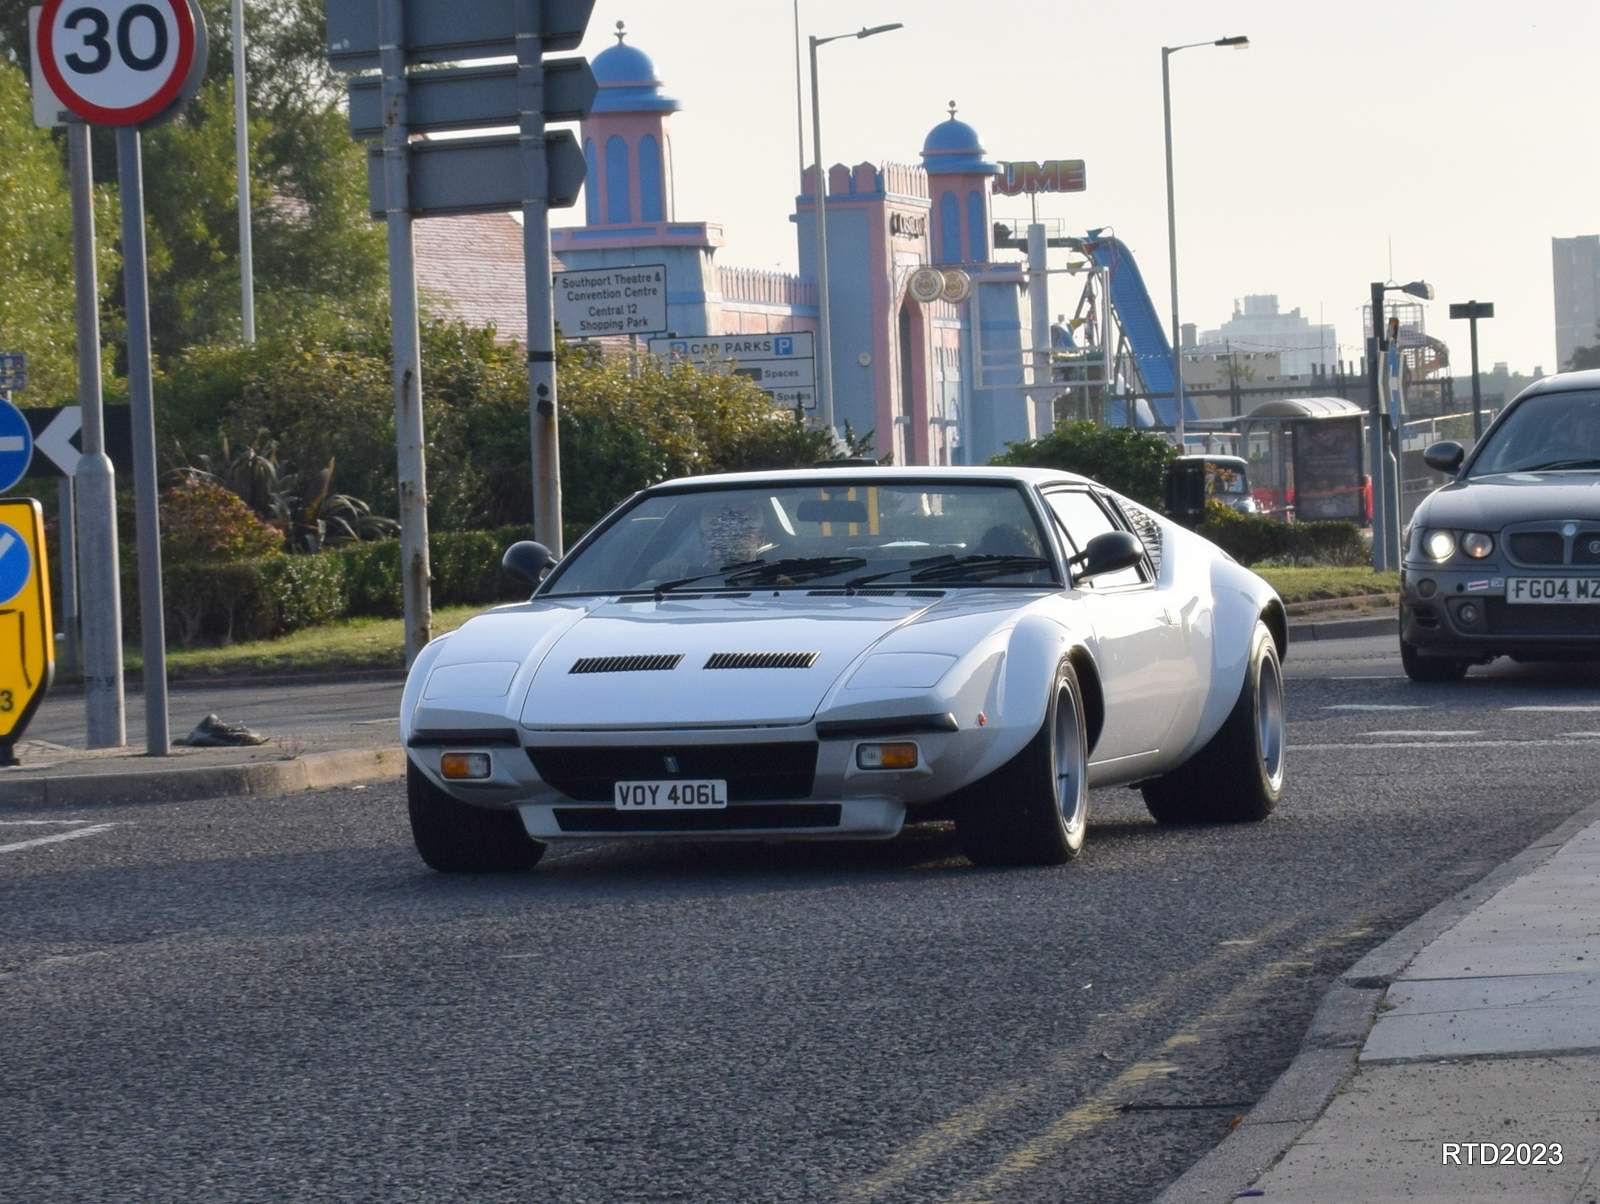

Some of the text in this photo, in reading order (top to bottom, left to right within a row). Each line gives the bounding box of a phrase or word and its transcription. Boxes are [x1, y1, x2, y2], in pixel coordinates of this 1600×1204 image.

[63, 3, 168, 75] 30
[992, 159, 1087, 196] UME
[562, 272, 661, 289] Southport Theatre &
[567, 286, 657, 302] Convention Centre
[588, 303, 638, 317] Central 12
[580, 316, 648, 331] Shopping Park
[725, 340, 772, 353] PARKS
[764, 369, 799, 378] Spaces
[1515, 580, 1570, 599] FG04
[619, 784, 725, 806] VOY 406L
